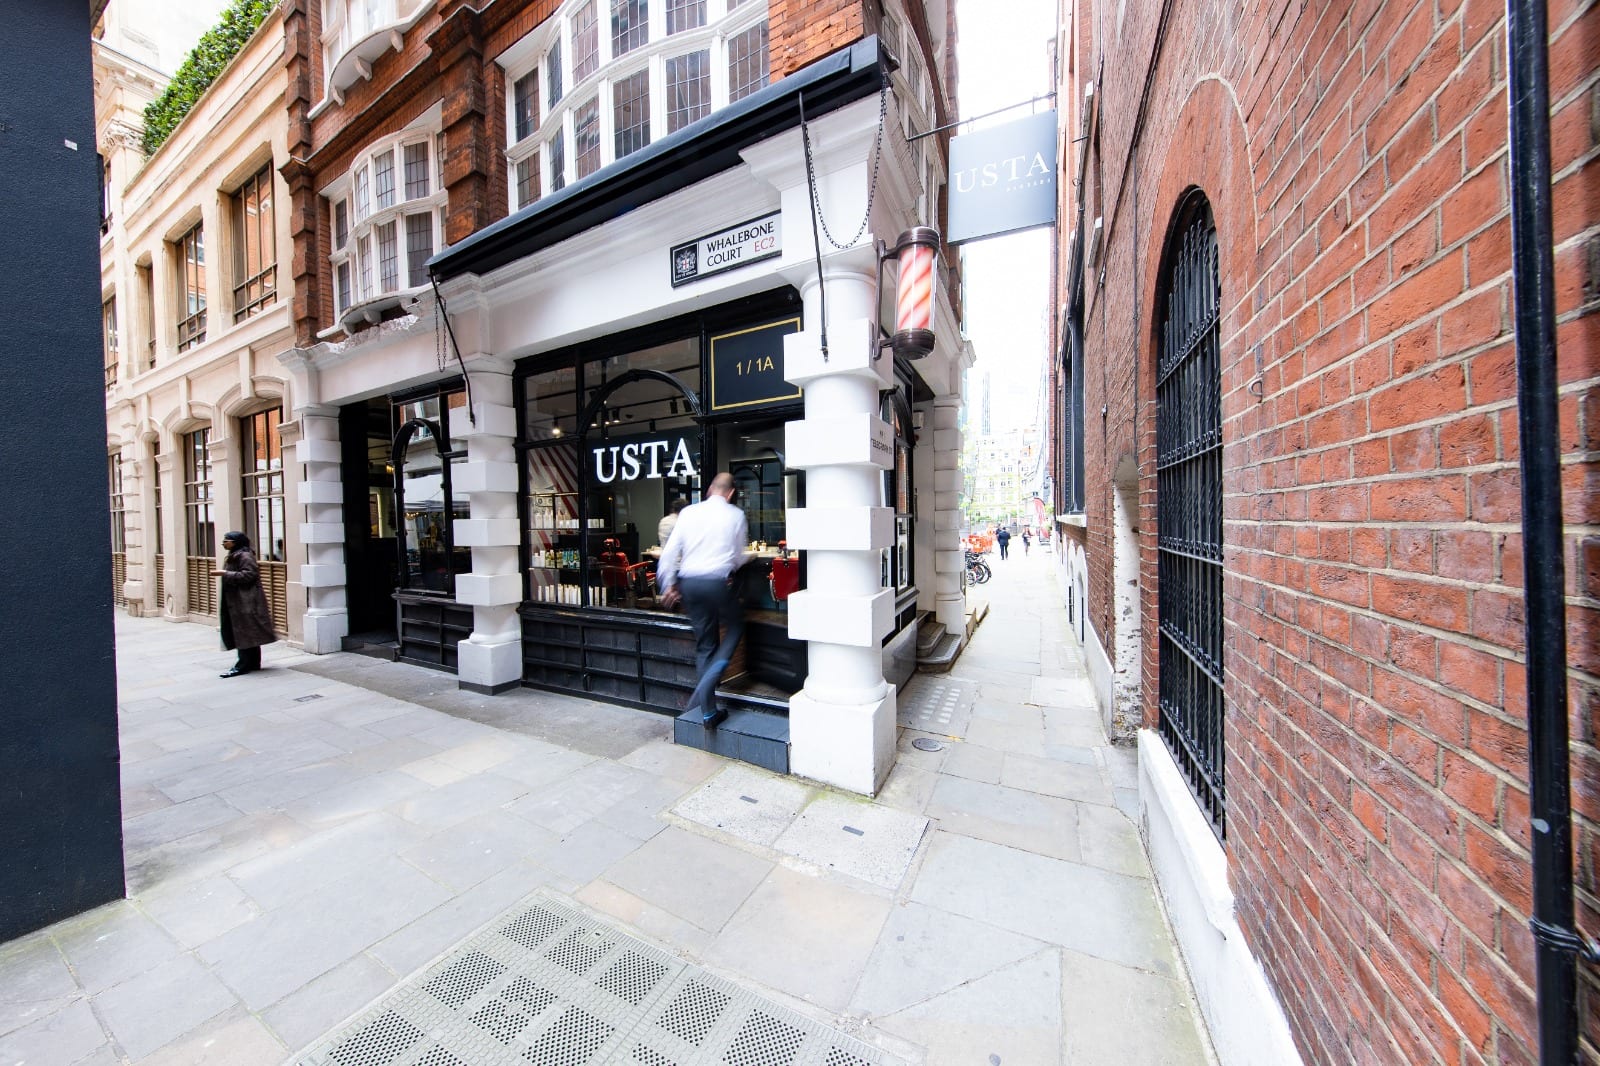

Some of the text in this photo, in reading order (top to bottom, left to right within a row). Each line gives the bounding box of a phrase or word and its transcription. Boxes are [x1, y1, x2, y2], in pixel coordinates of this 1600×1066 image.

[954, 151, 1051, 193] USTA
[707, 221, 775, 253] WHALEBONE
[707, 236, 775, 267] COURT EC2
[736, 361, 742, 376] 1
[756, 355, 775, 372] 1A
[592, 437, 697, 484] USTA
